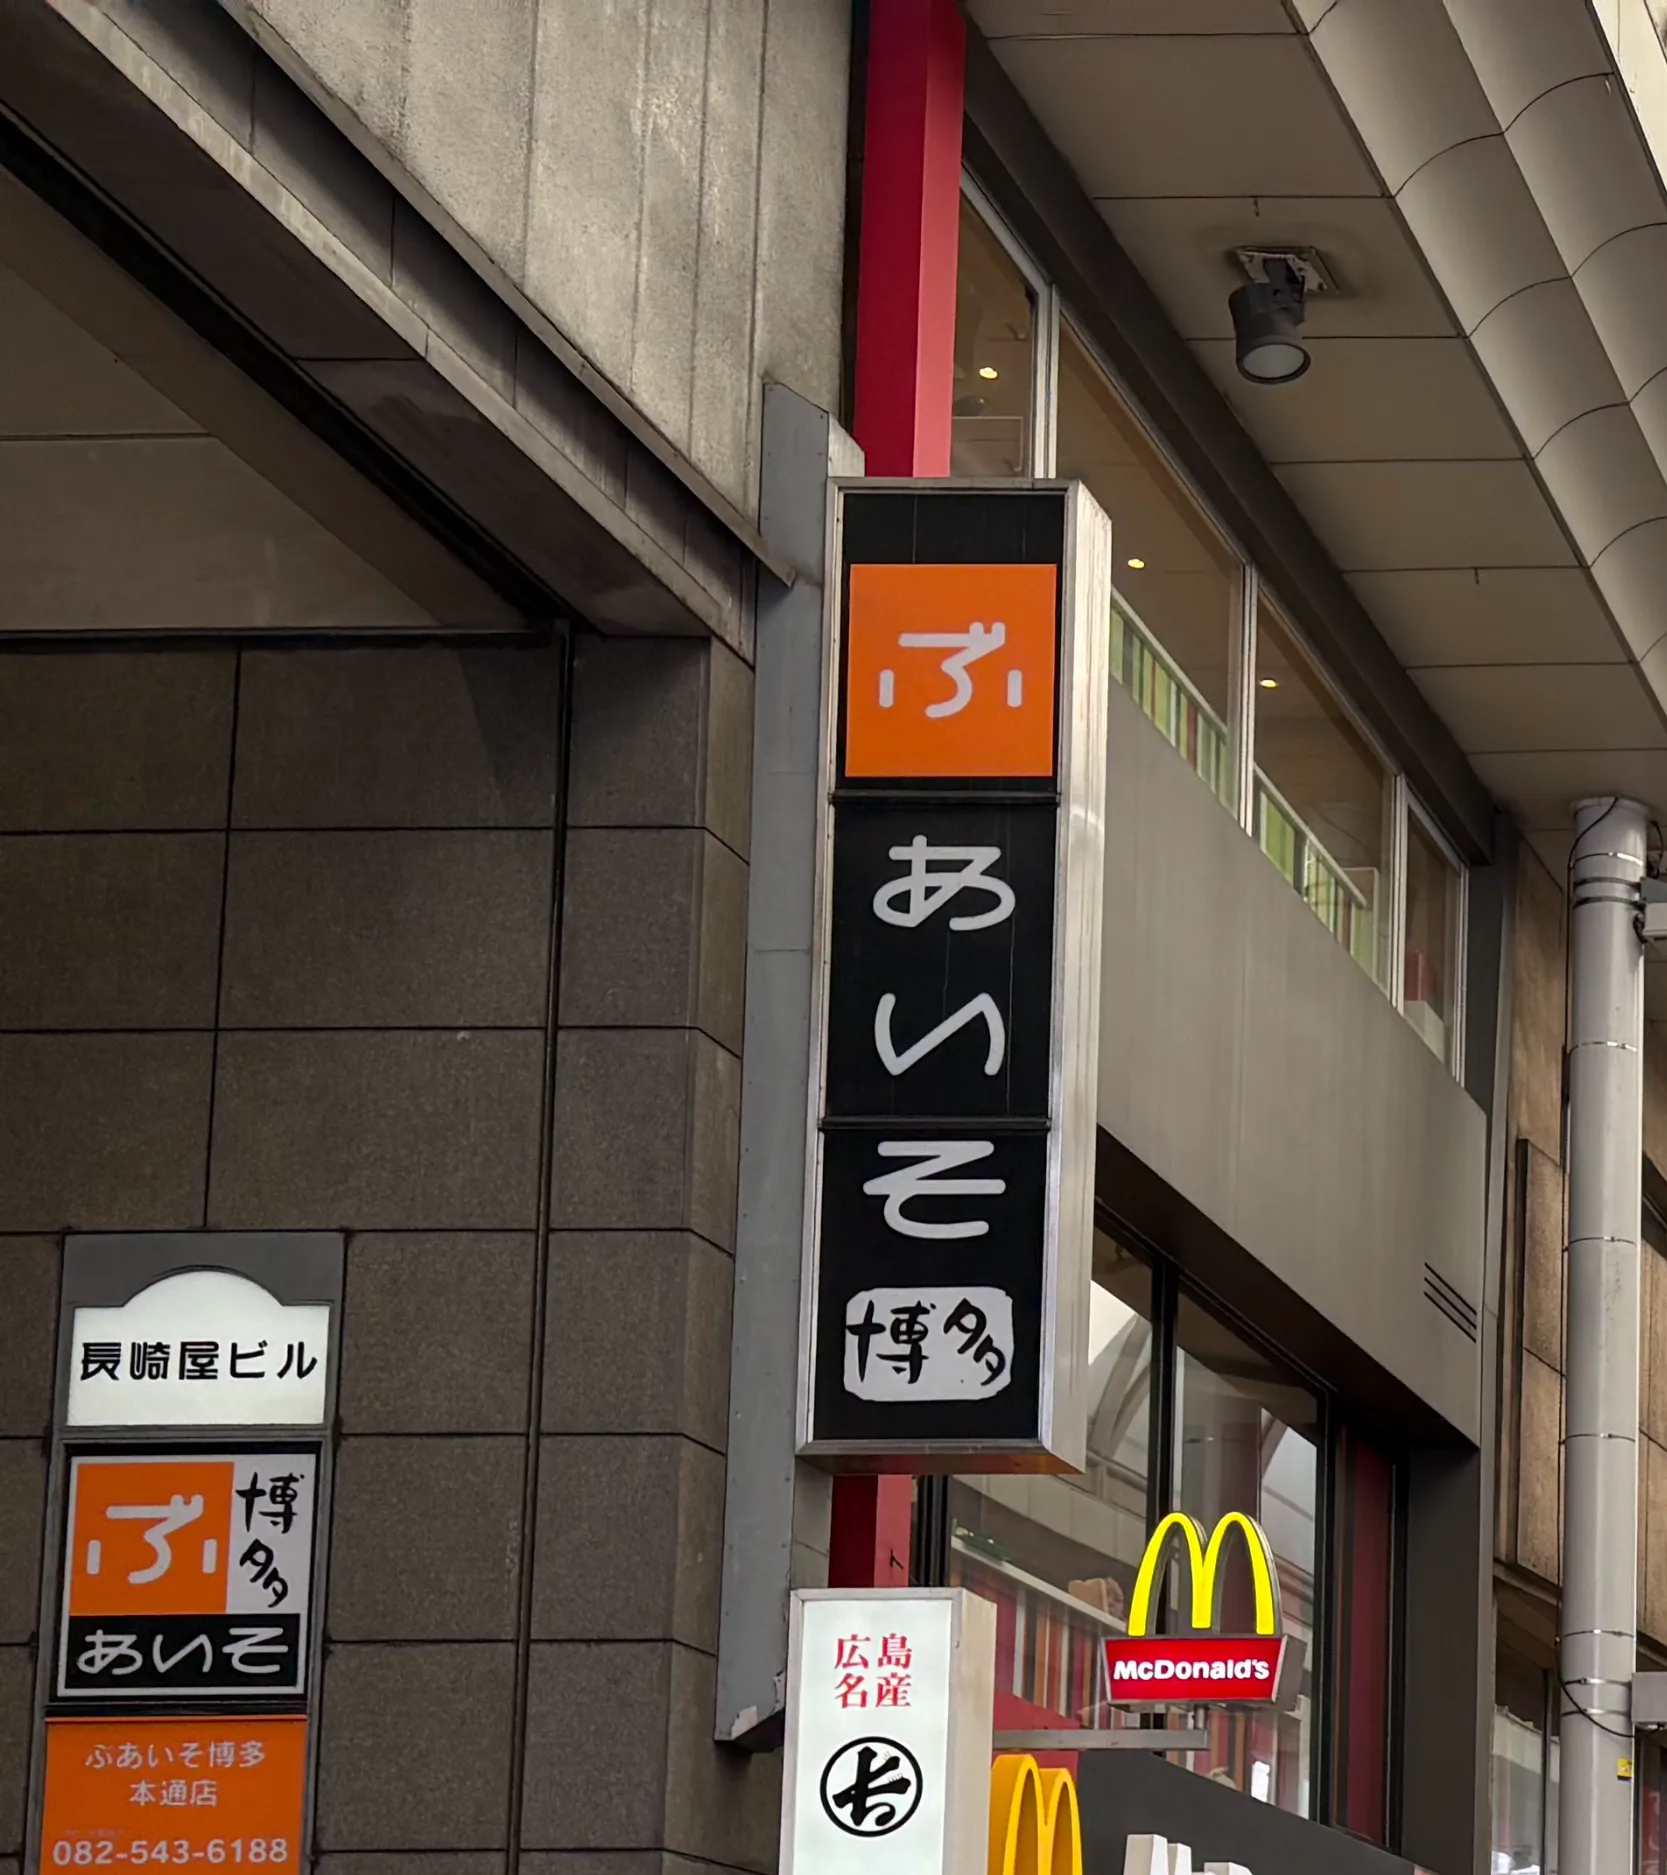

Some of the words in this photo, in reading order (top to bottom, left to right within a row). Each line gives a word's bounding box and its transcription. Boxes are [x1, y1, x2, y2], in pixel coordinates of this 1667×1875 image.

[79, 1339, 319, 1383] 長崎屋ビル
[845, 1300, 1012, 1388] 博多
[236, 1472, 297, 1609] 博多
[77, 1624, 289, 1677] あいそ
[1113, 1658, 1272, 1684] McDonald's
[85, 1741, 266, 1769] ぶあいそ博多
[129, 1779, 218, 1808] 本通店
[52, 1837, 289, 1867] 082-543-6188
